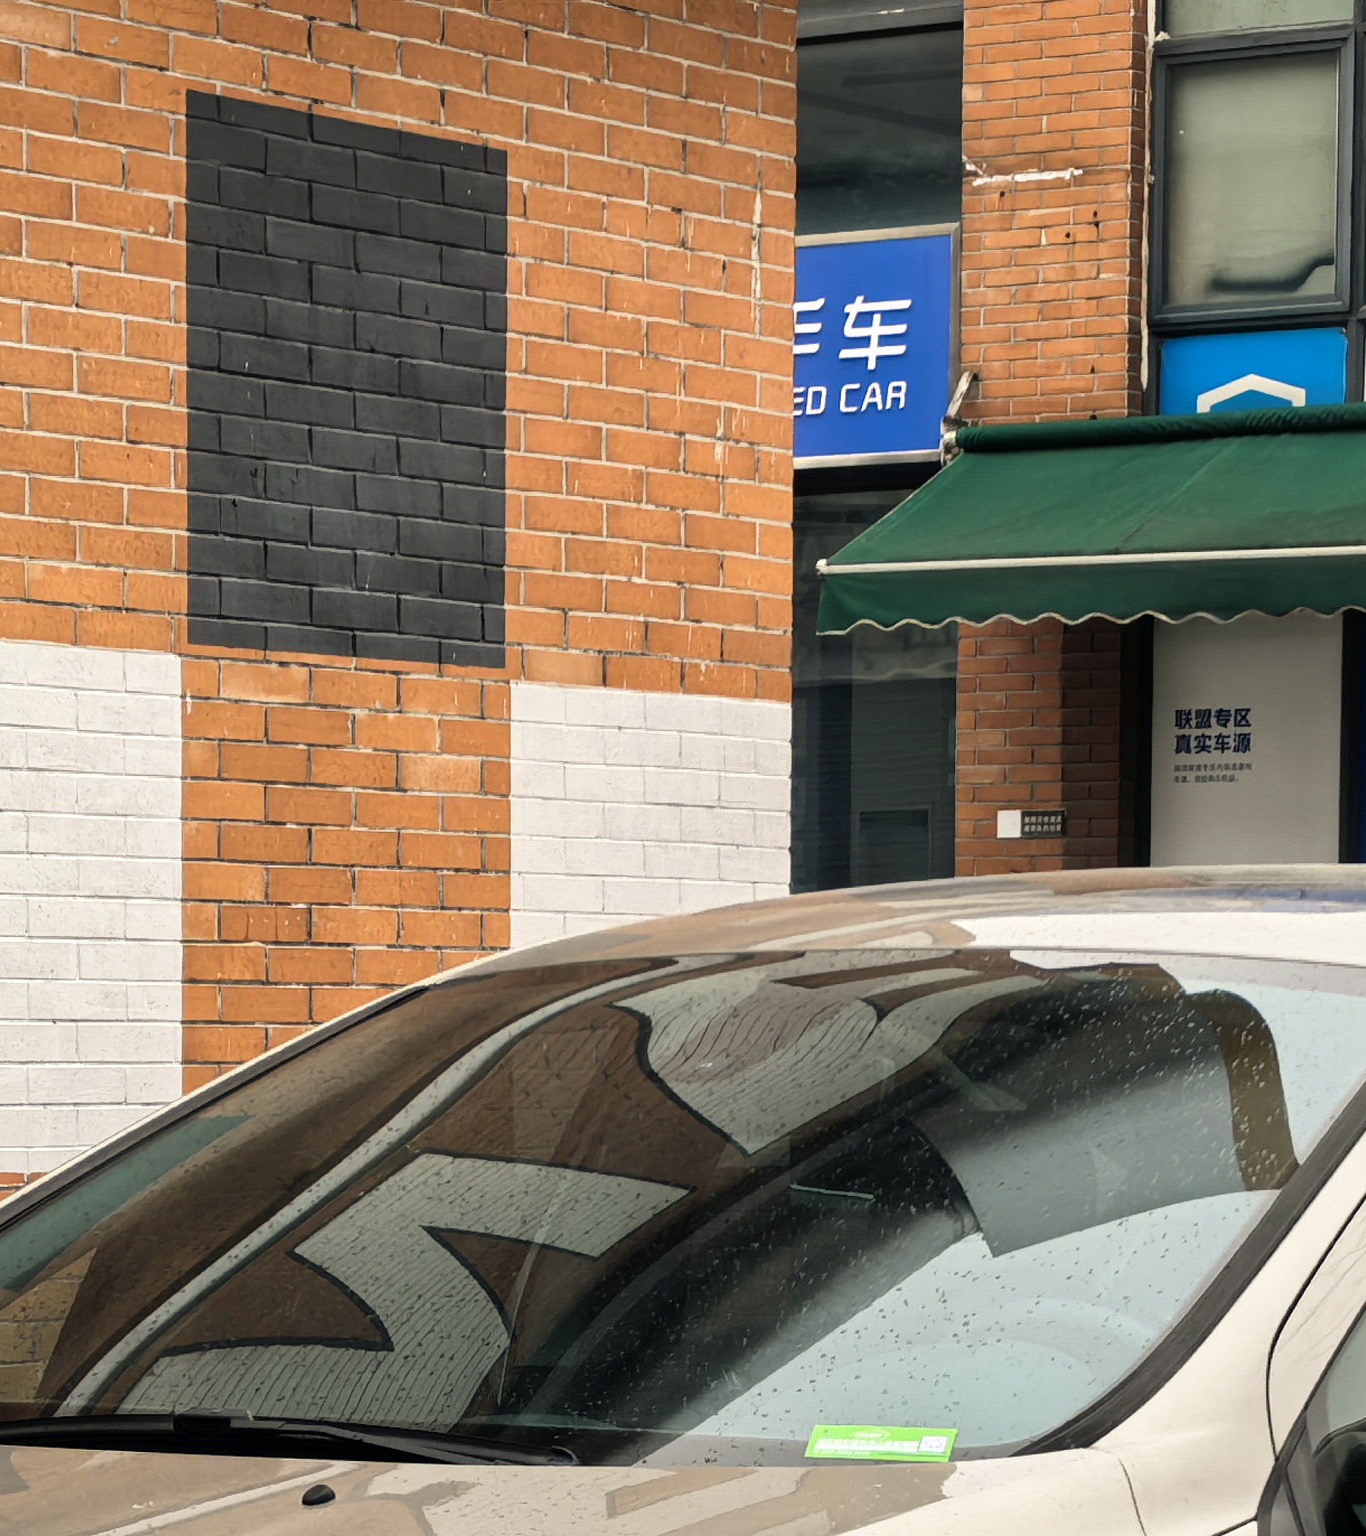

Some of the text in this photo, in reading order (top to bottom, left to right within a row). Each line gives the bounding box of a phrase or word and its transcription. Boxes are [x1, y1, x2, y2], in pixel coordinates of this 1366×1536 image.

[839, 381, 907, 413] CAR
[1174, 707, 1252, 730] 联盟专区
[1174, 732, 1252, 755] 真实车源
